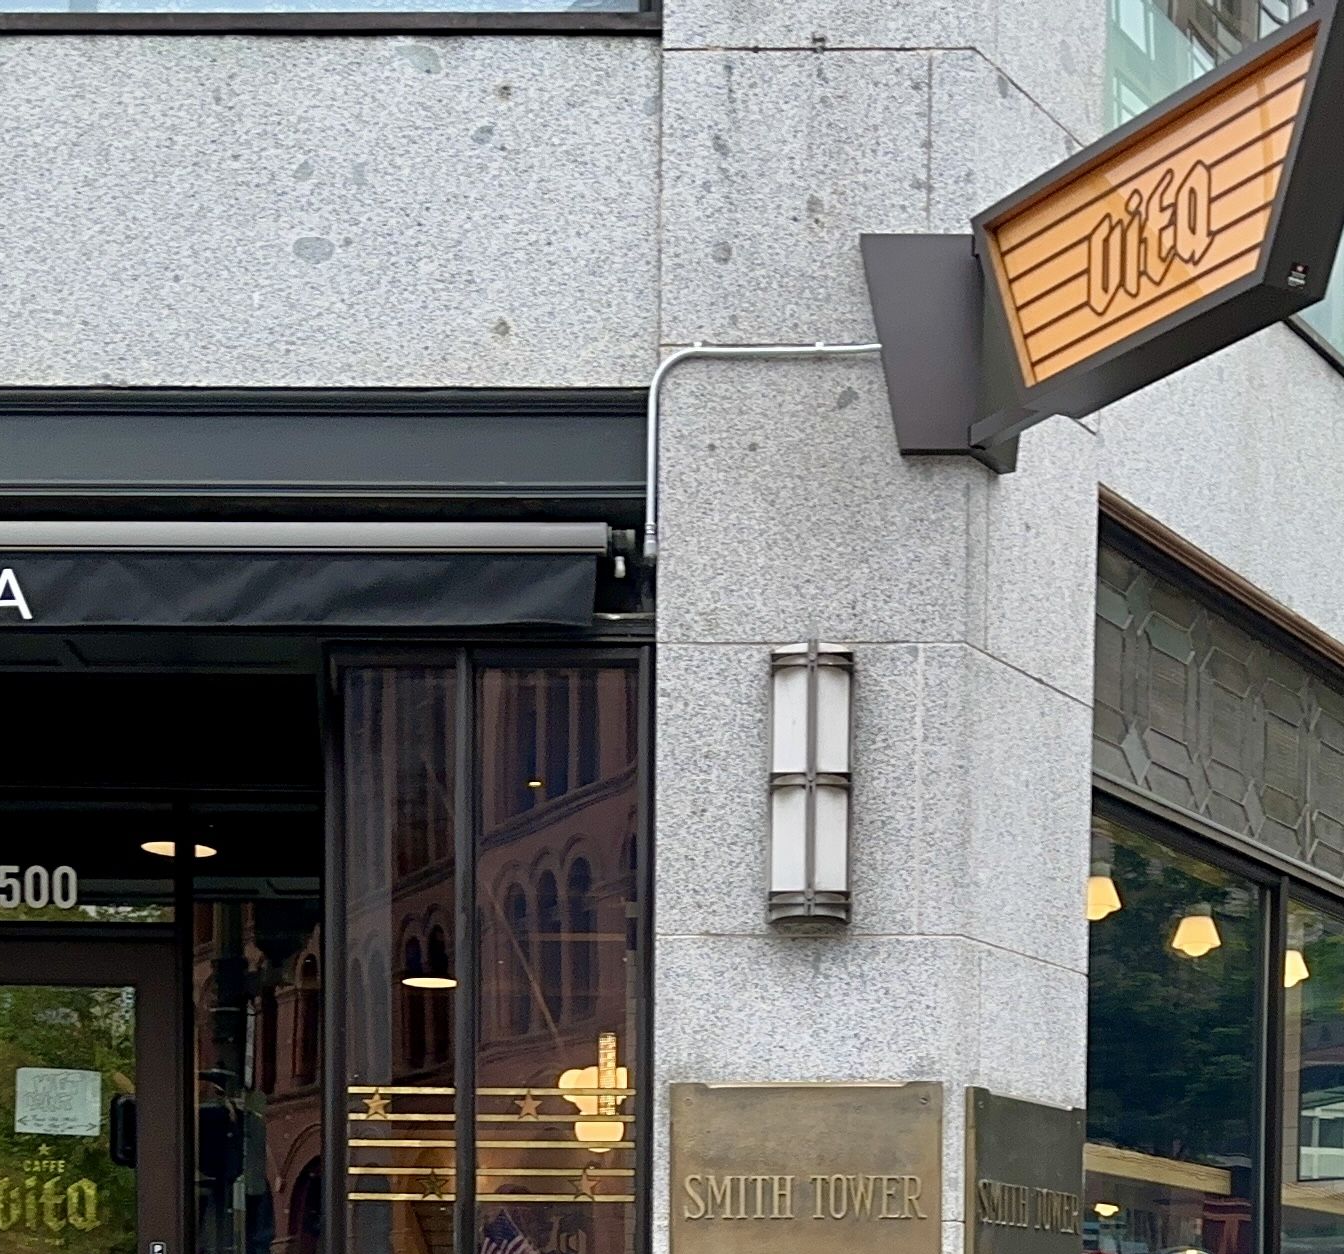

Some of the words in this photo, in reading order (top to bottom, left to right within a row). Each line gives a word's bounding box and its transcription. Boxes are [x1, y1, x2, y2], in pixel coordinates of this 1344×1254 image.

[23, 1160, 65, 1172] CAFFE
[683, 1174, 796, 1220] SMITH
[809, 1173, 928, 1220] TOWER
[978, 1178, 1029, 1228] SMITH
